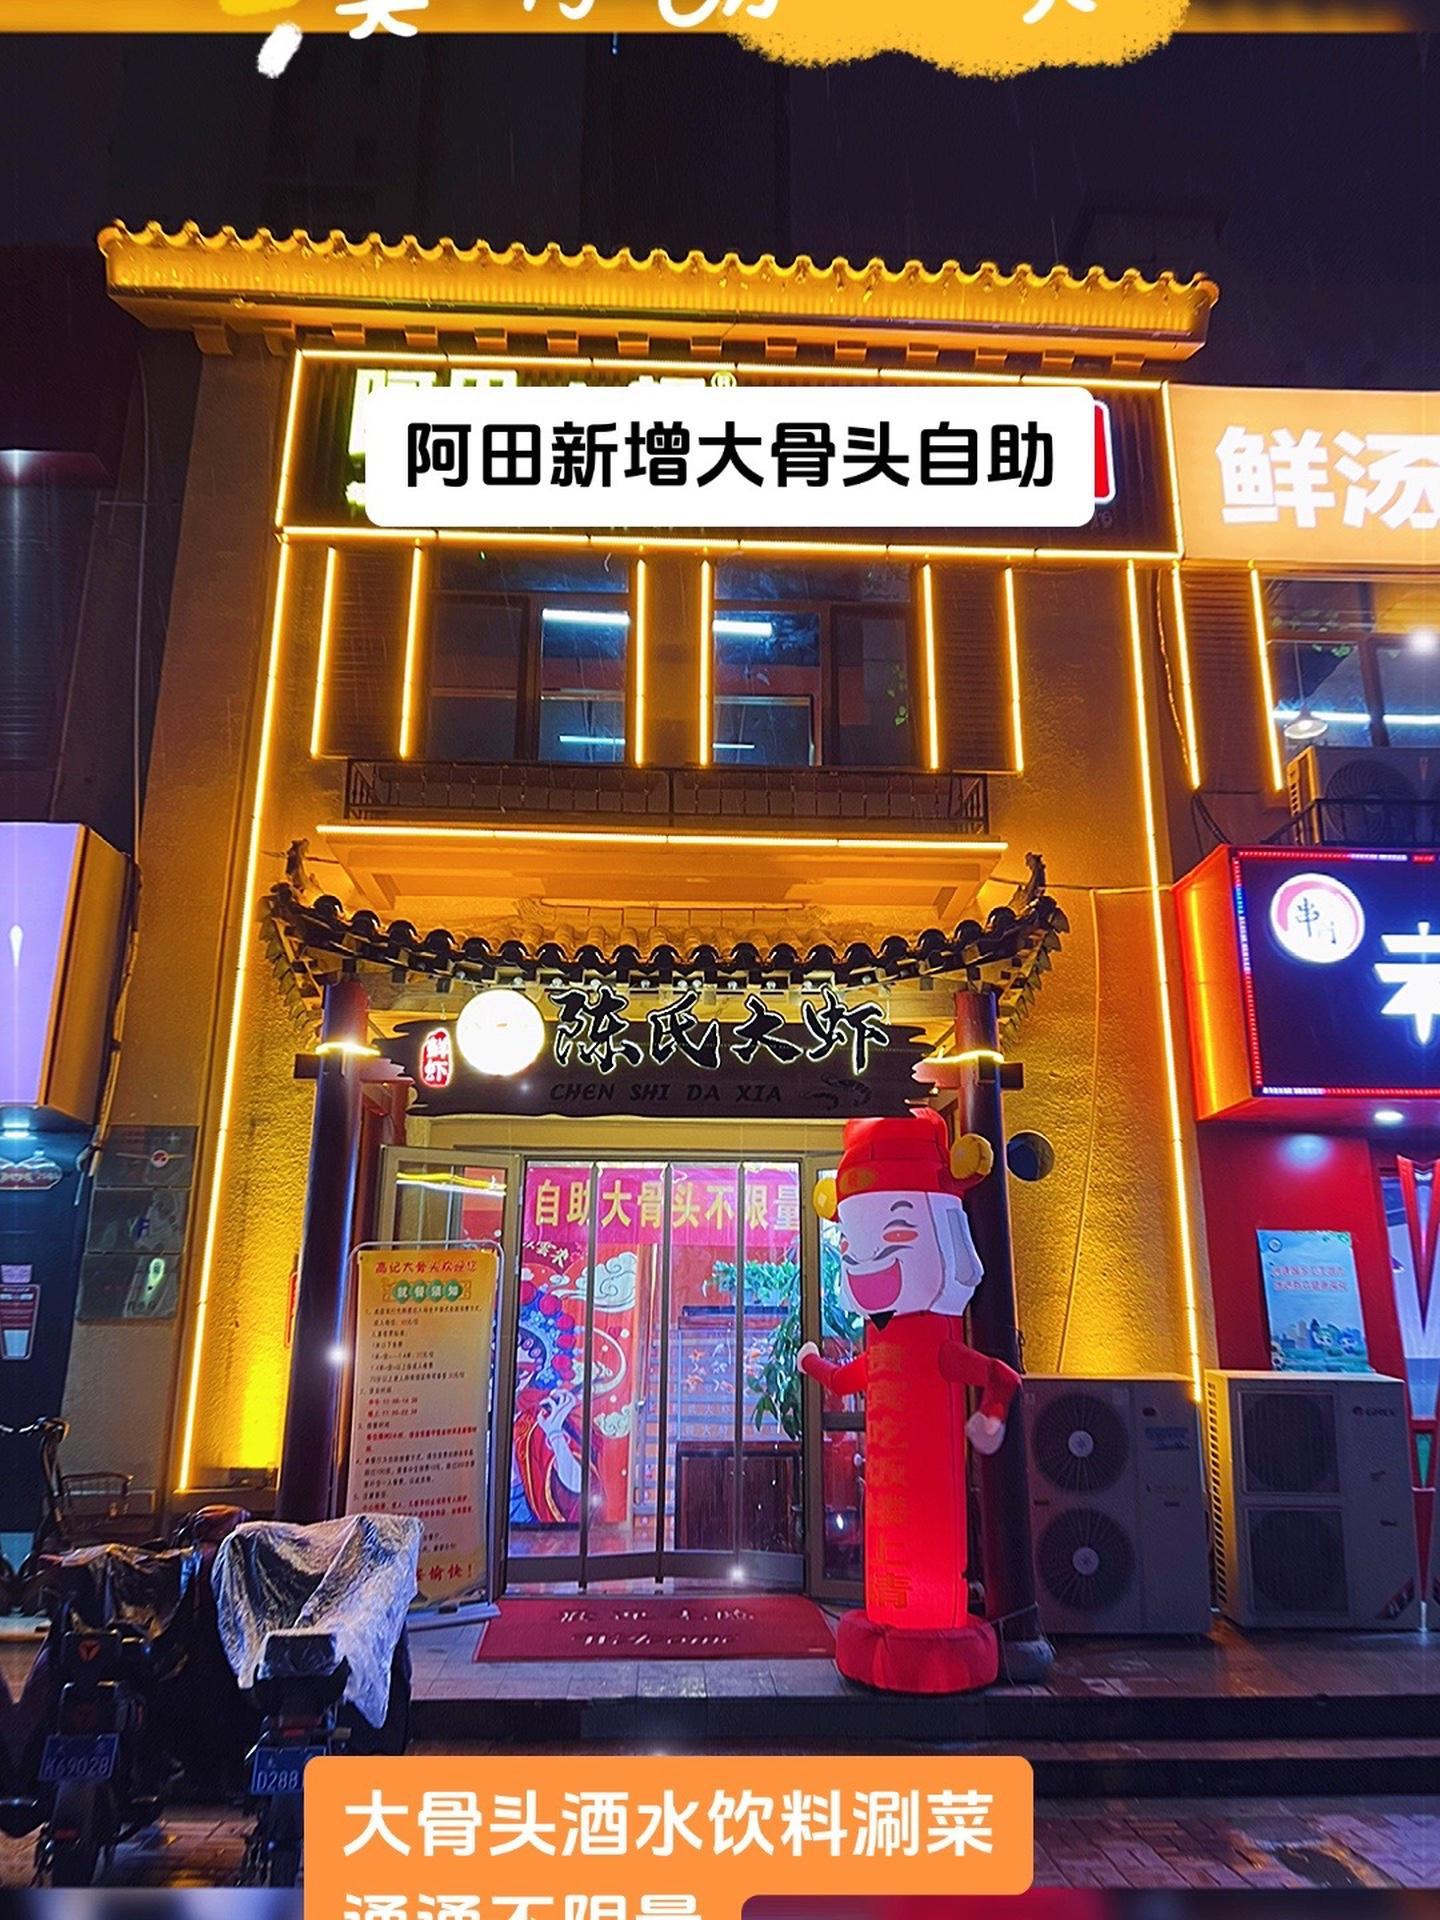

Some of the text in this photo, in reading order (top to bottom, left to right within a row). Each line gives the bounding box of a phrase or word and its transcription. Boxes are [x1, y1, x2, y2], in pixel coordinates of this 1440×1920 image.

[1215, 425, 1440, 529] 鲜汤
[550, 985, 890, 1075] 陈氏大虾
[549, 1083, 782, 1103] CHEN SHI DA XIA
[535, 1178, 800, 1231] 自助大骨头不限量
